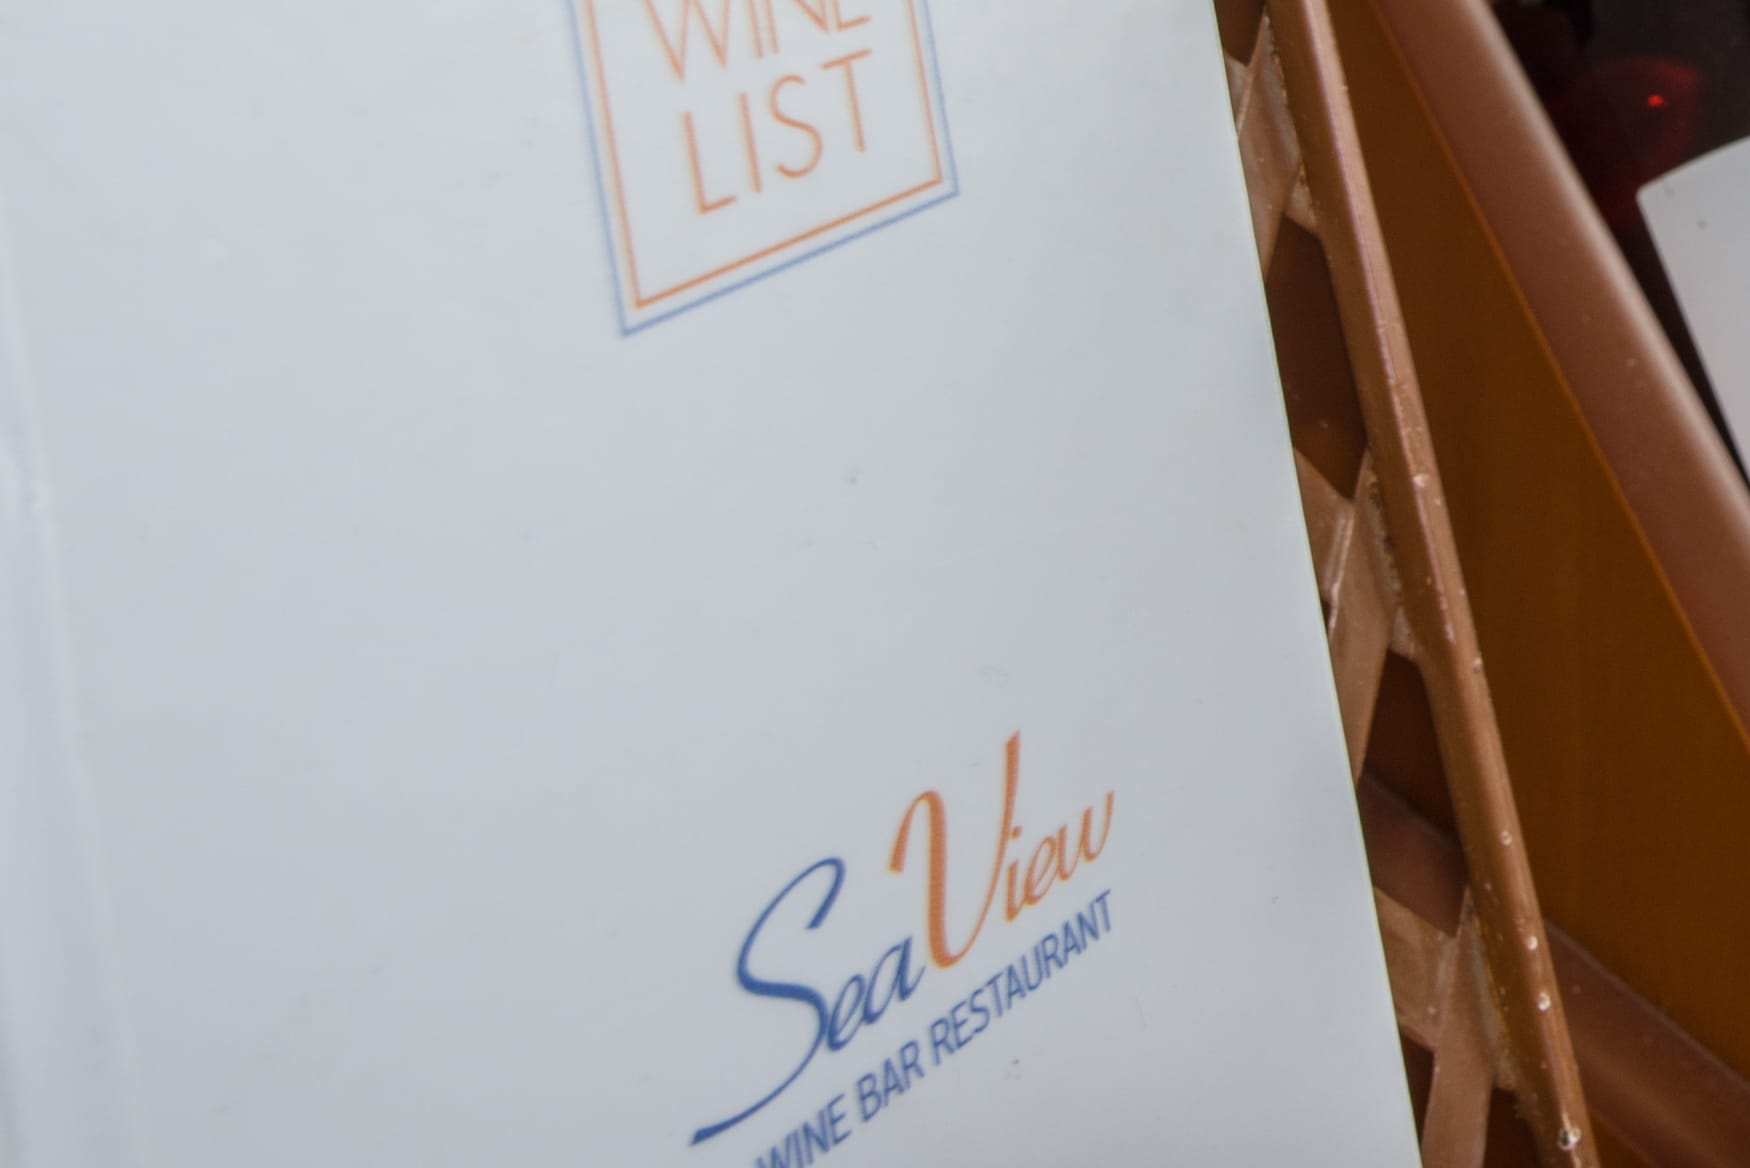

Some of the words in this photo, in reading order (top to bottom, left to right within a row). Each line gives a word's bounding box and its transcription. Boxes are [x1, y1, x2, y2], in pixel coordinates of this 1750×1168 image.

[681, 47, 873, 215] LIST
[690, 855, 928, 1147] Sea
[886, 728, 1116, 970] View
[855, 1038, 926, 1124] BAR
[928, 887, 1112, 1067] RESTAURANT
